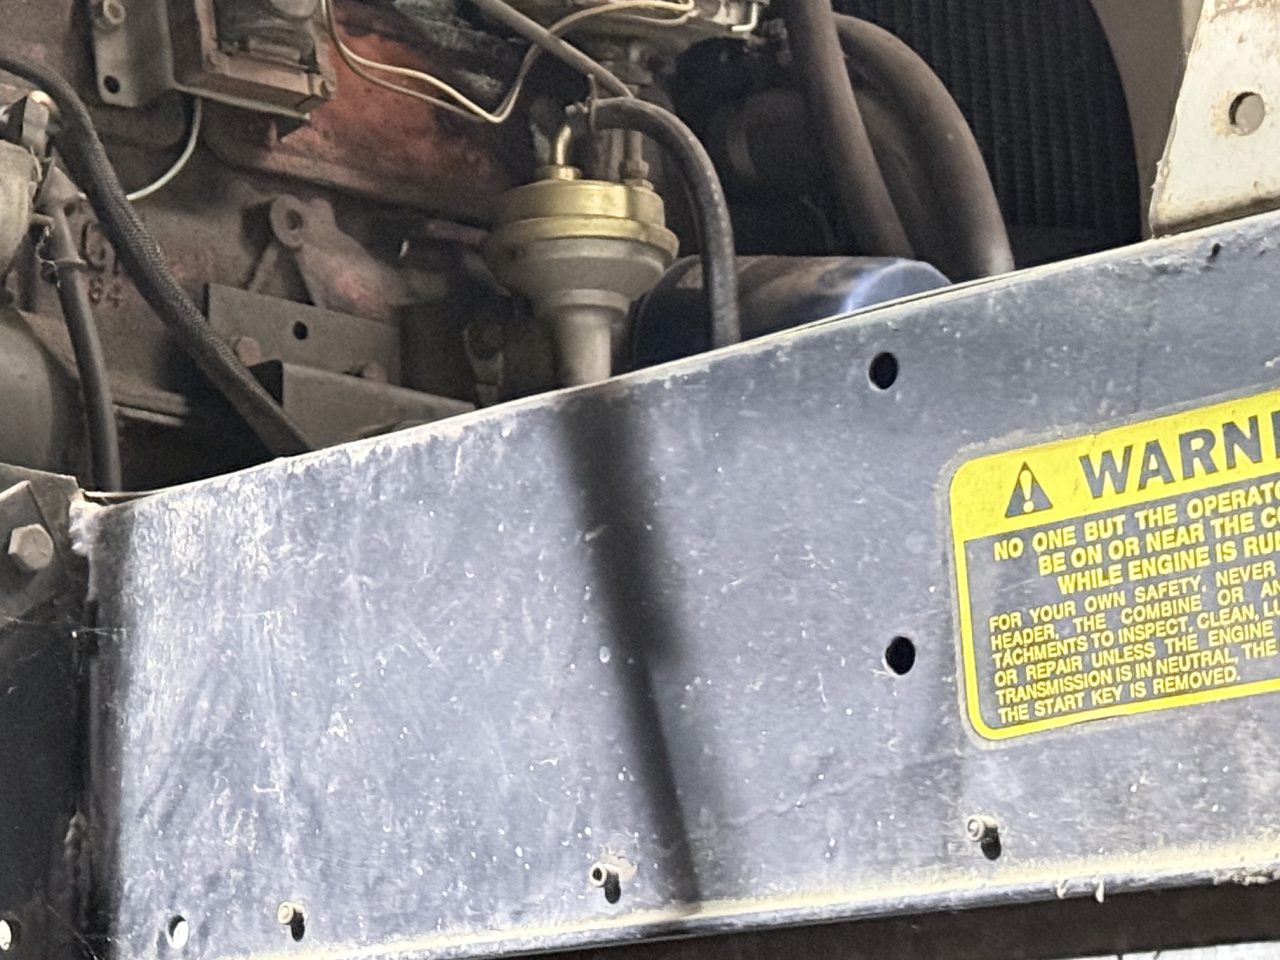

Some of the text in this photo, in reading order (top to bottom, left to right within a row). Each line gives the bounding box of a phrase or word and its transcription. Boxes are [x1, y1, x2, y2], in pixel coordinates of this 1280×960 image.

[993, 536, 1024, 561] NO
[1031, 525, 1077, 552] ONE
[1083, 514, 1126, 542] BUT
[1134, 503, 1178, 530] THE
[1038, 551, 1067, 576] BE
[1070, 543, 1103, 568] ON
[1107, 536, 1140, 561] OR
[1145, 522, 1206, 554] NEAR
[1210, 511, 1255, 539] THE
[989, 611, 1022, 633] FOR
[1028, 600, 1077, 624] YOUR
[1083, 590, 1126, 613] OWN
[1215, 560, 1276, 587] NEVER
[1057, 564, 1124, 595] WHILE
[1128, 545, 1210, 581] ENGINE
[1215, 540, 1238, 563] IS
[1072, 612, 1107, 633] THE
[1120, 594, 1202, 625] COMBINE
[1216, 586, 1244, 606] OR
[992, 635, 1089, 669] TACHMENTS
[1090, 630, 1114, 649] TO
[994, 619, 1274, 688] OR REPAIR UNLESS THE ENGINE
[995, 667, 1113, 706] TRANSMISSION
[1115, 664, 1133, 682] IS
[1135, 660, 1153, 679] IN
[1241, 638, 1278, 660] THE
[998, 703, 1030, 724] THE
[1034, 691, 1085, 717] START
[1091, 684, 1123, 706] KEY
[1130, 681, 1147, 699] IS
